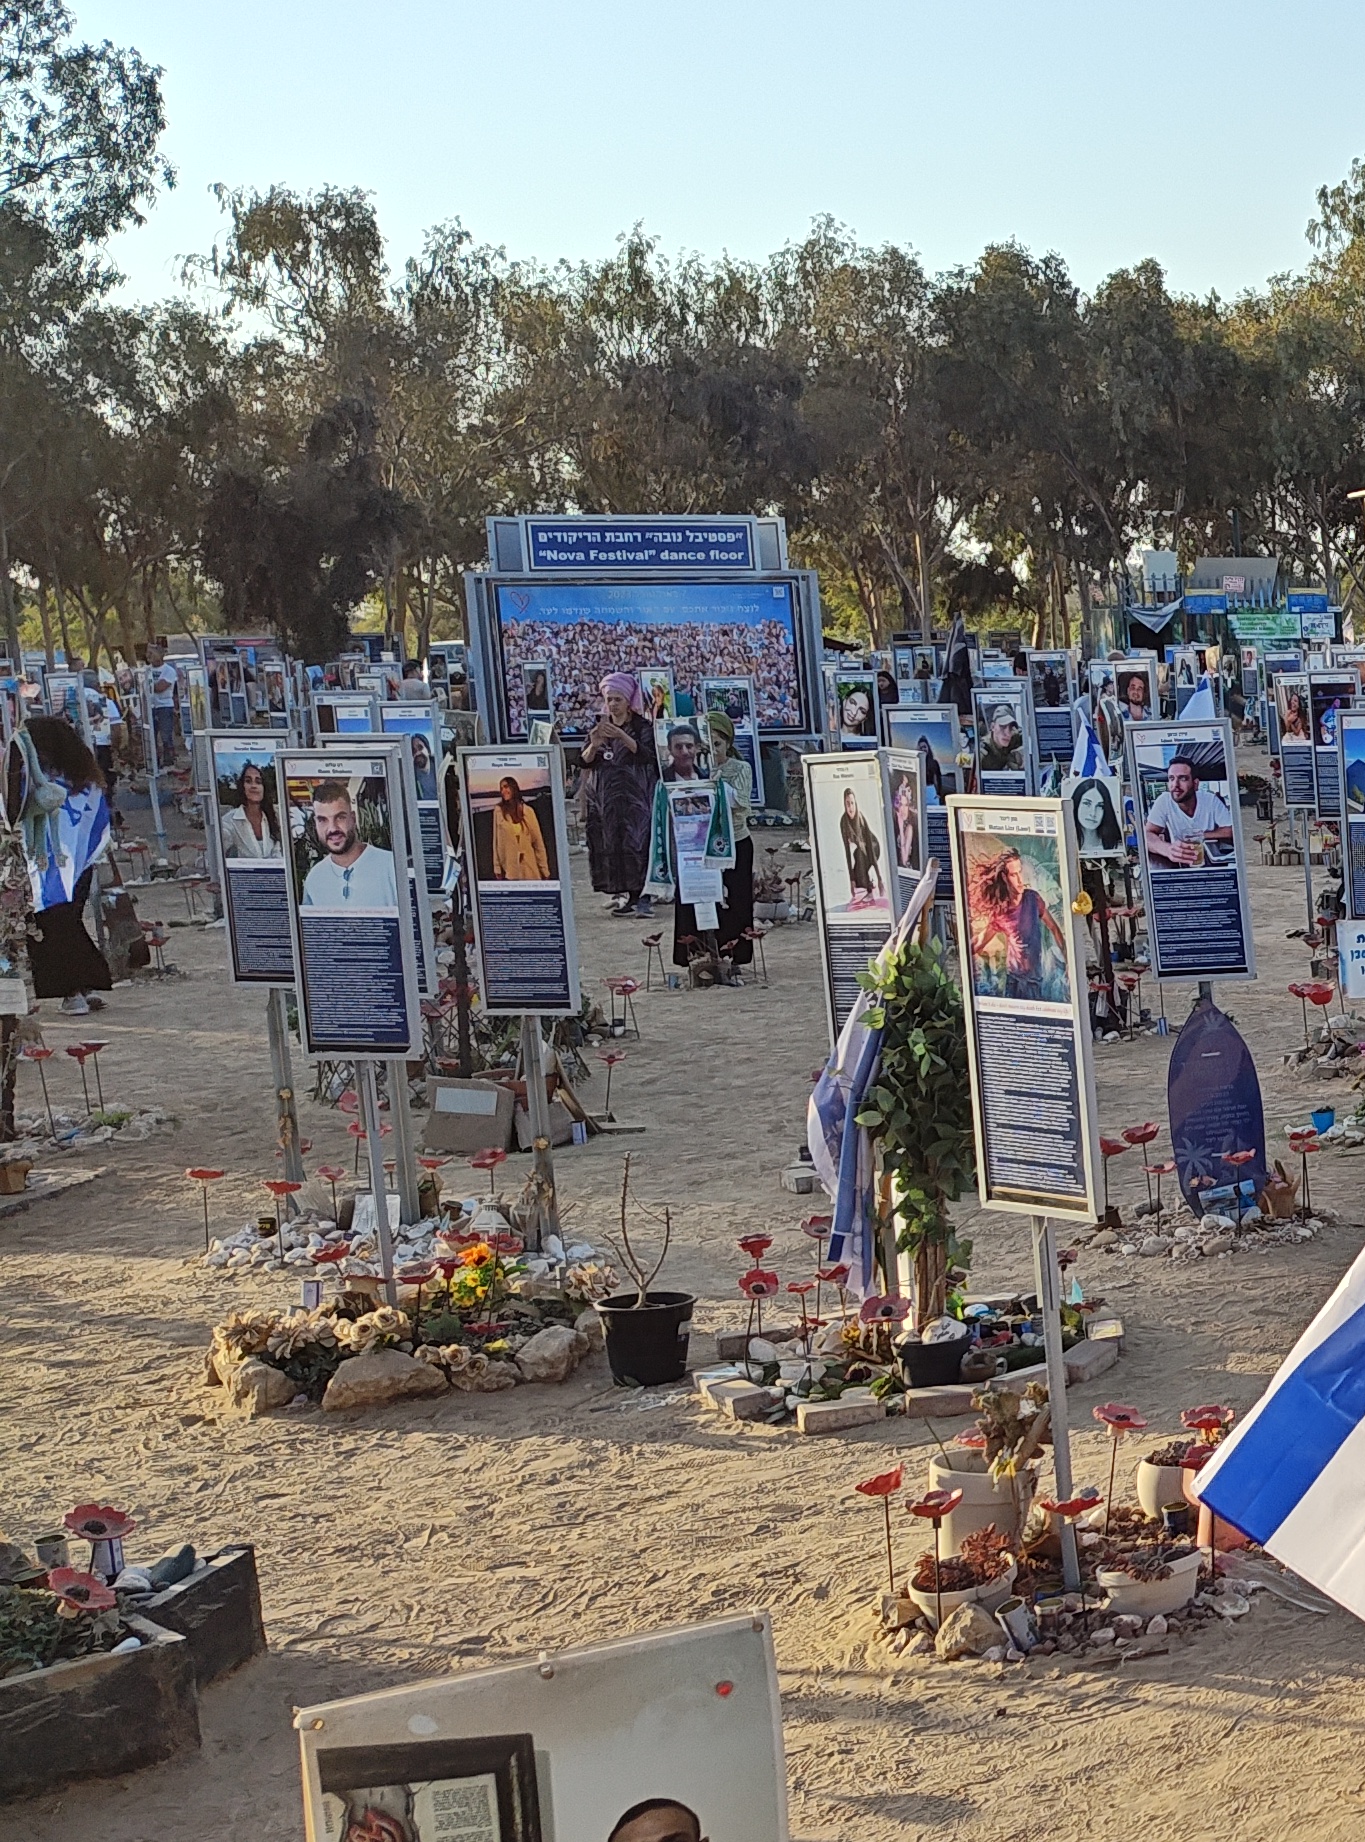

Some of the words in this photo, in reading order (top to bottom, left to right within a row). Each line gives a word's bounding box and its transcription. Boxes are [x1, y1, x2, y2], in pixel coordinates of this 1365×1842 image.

[538, 530, 601, 544] הריקודים
[605, 530, 641, 544] רחבת
[659, 549, 706, 562] dance
[709, 548, 744, 562] floor
